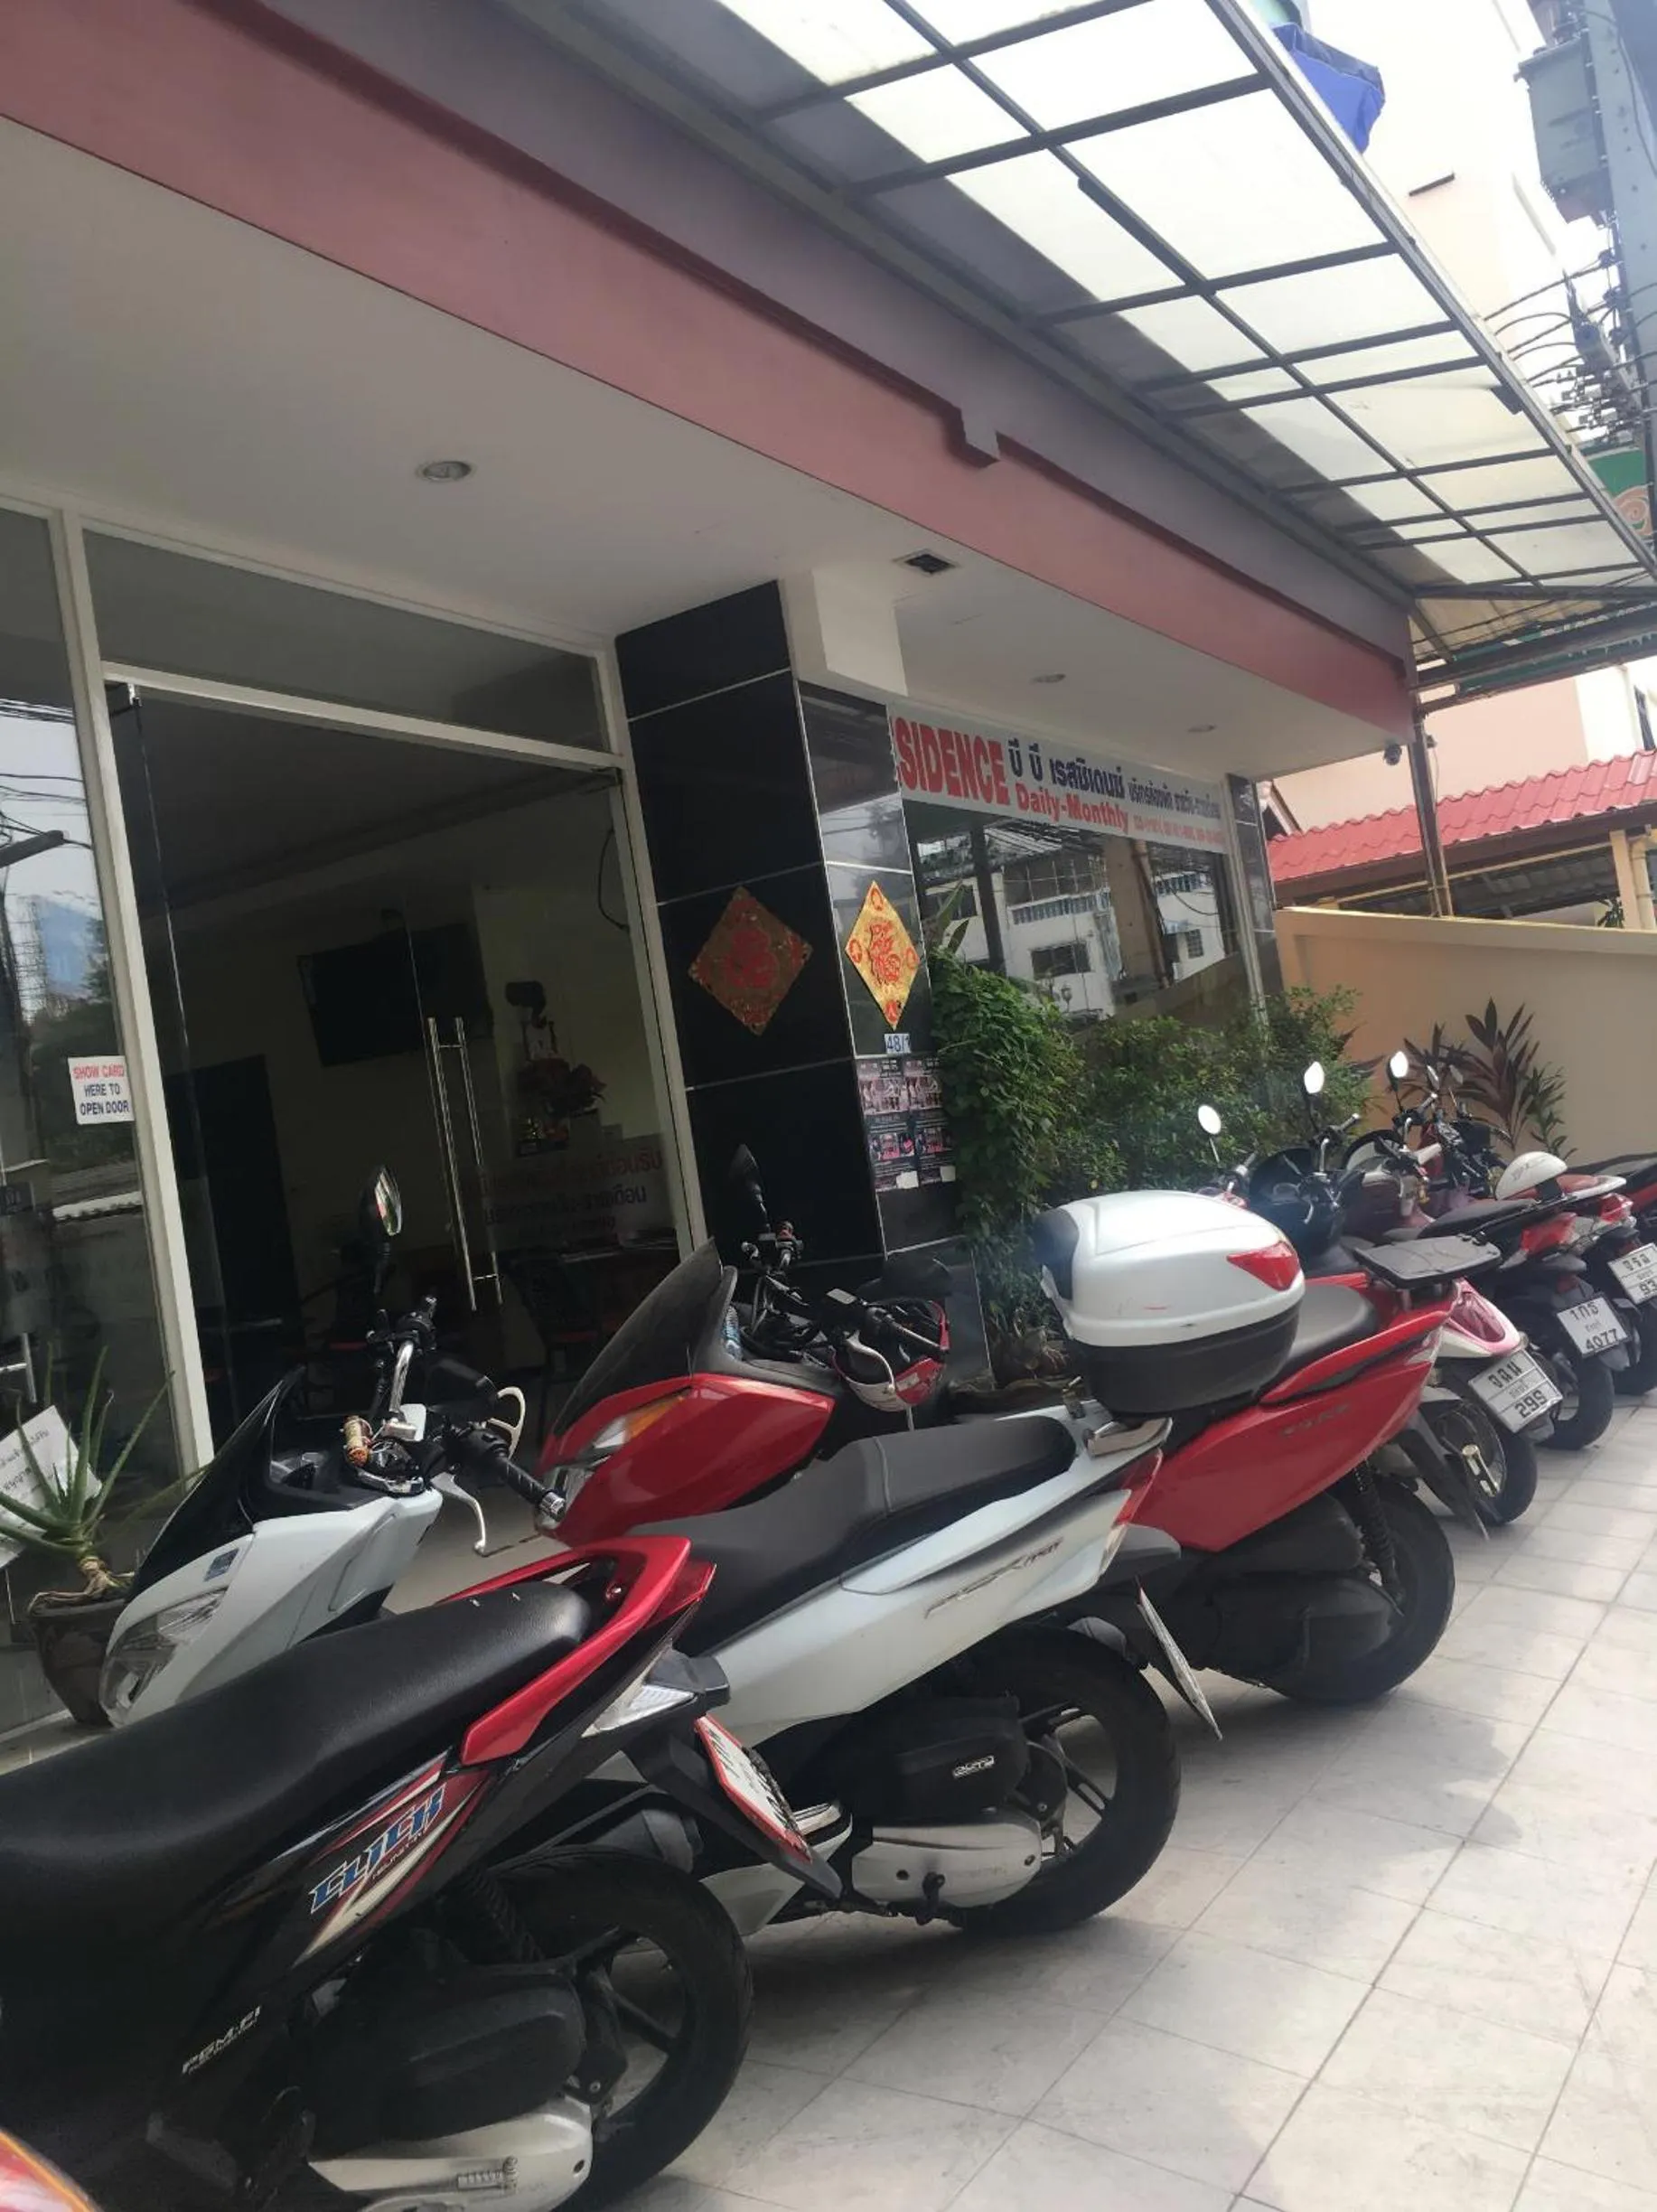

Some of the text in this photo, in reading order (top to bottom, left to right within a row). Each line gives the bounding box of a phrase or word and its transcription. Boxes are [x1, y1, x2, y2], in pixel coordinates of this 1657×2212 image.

[891, 717, 1010, 806] SIDENCE
[72, 1065, 99, 1080] SHOW
[84, 1083, 120, 1097] HERE TO
[79, 1100, 130, 1116] OPEN DOOR
[1586, 1328, 1618, 1350] 4077
